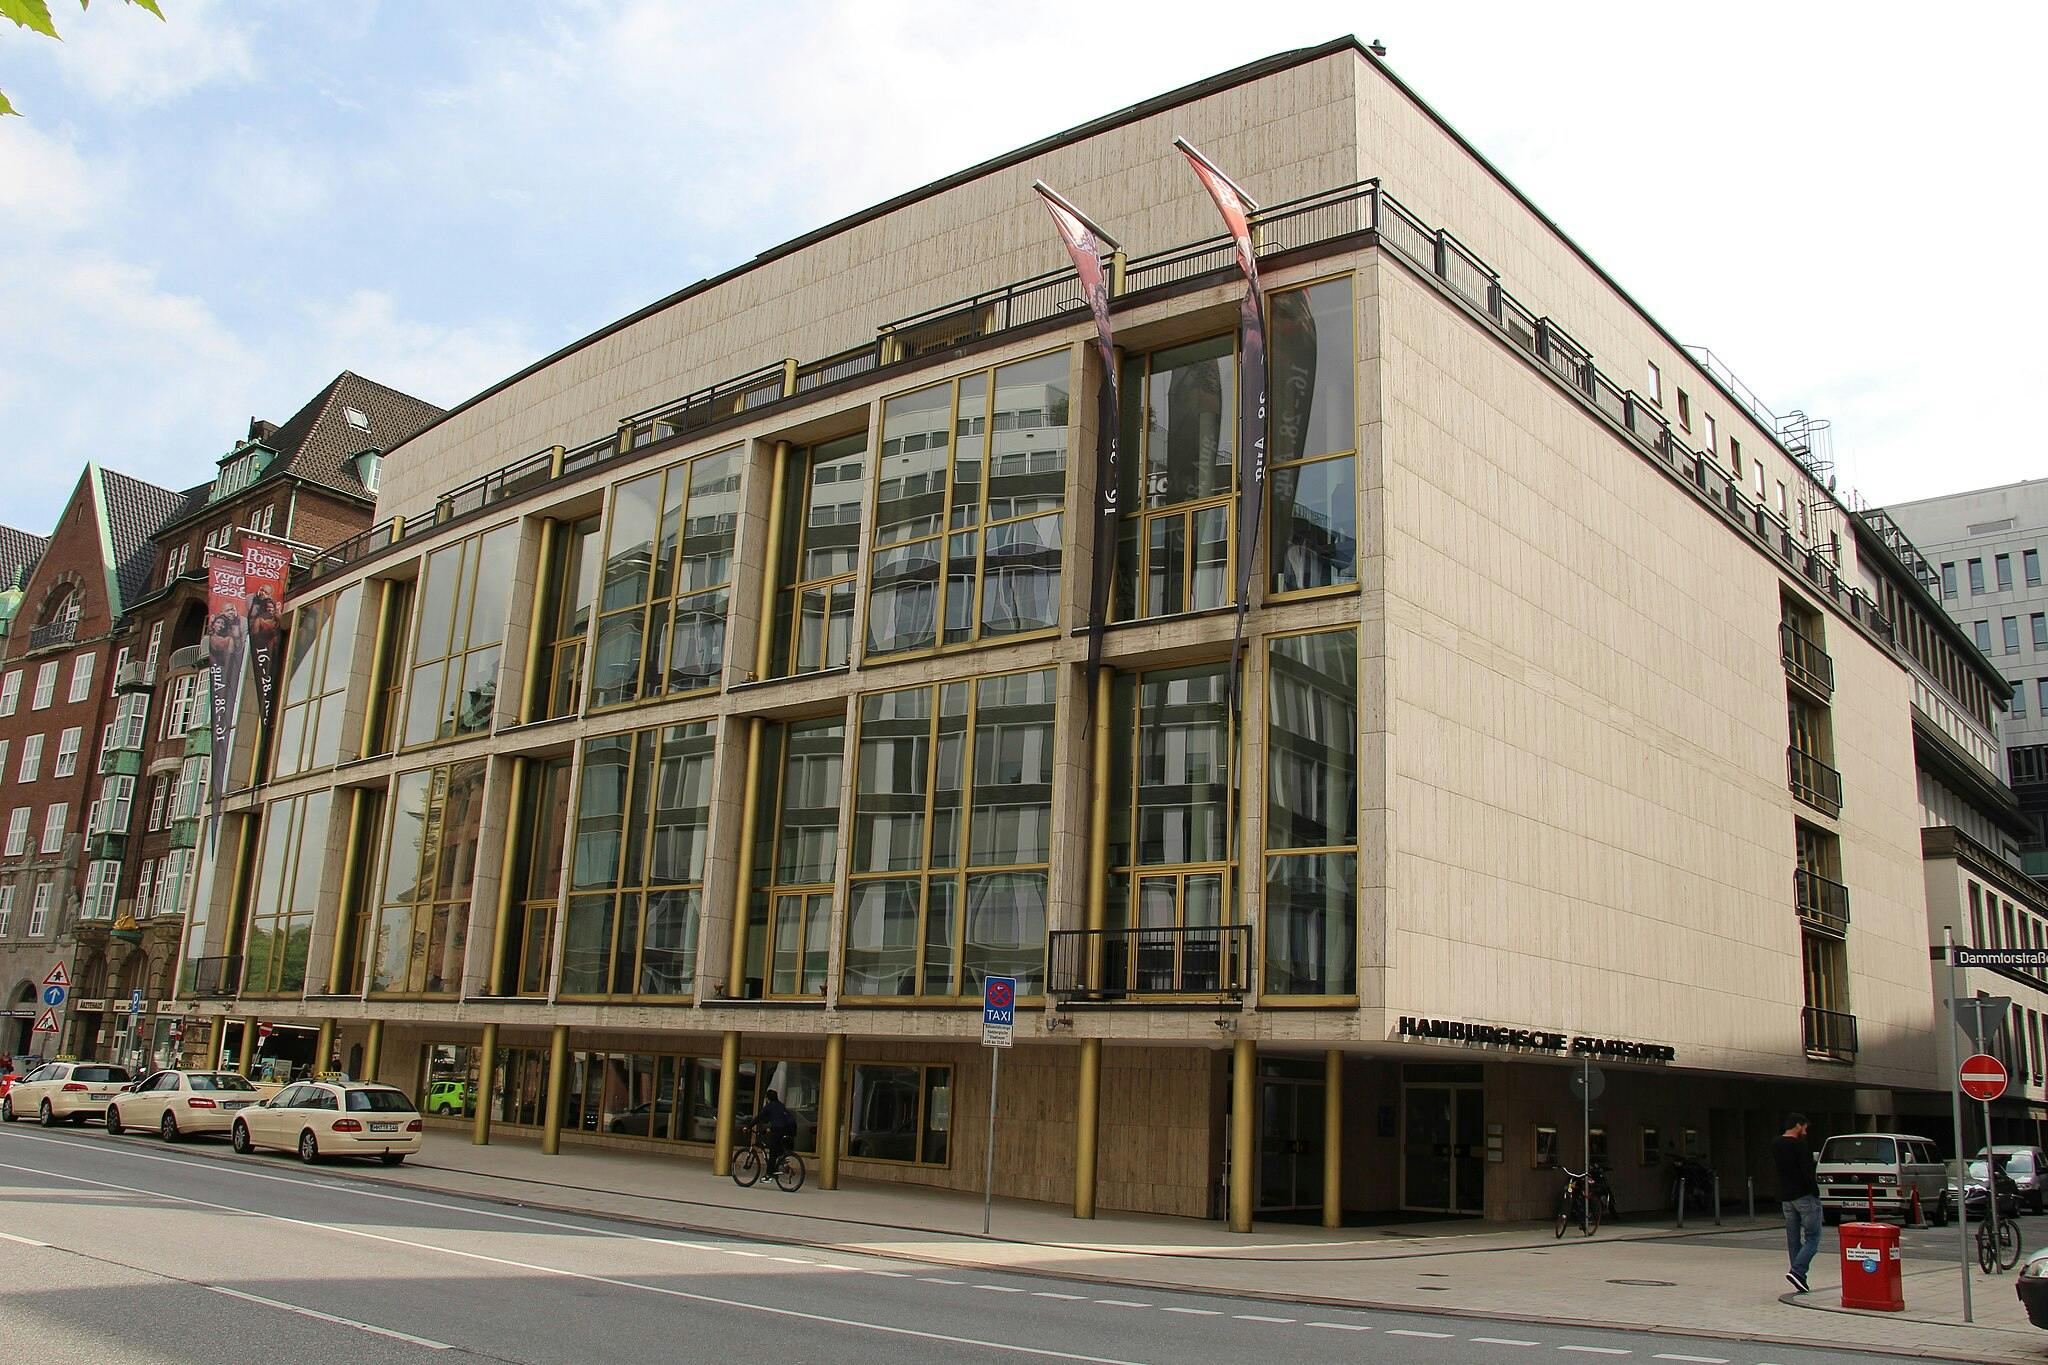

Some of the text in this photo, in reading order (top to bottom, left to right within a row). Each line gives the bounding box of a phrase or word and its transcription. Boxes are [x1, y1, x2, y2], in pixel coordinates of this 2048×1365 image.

[245, 547, 287, 571] Porgy
[244, 561, 280, 580] Bess
[986, 1009, 1011, 1022] TAXI
[1400, 1016, 1676, 1061] HAMBURGISCHE STAATSOPER
